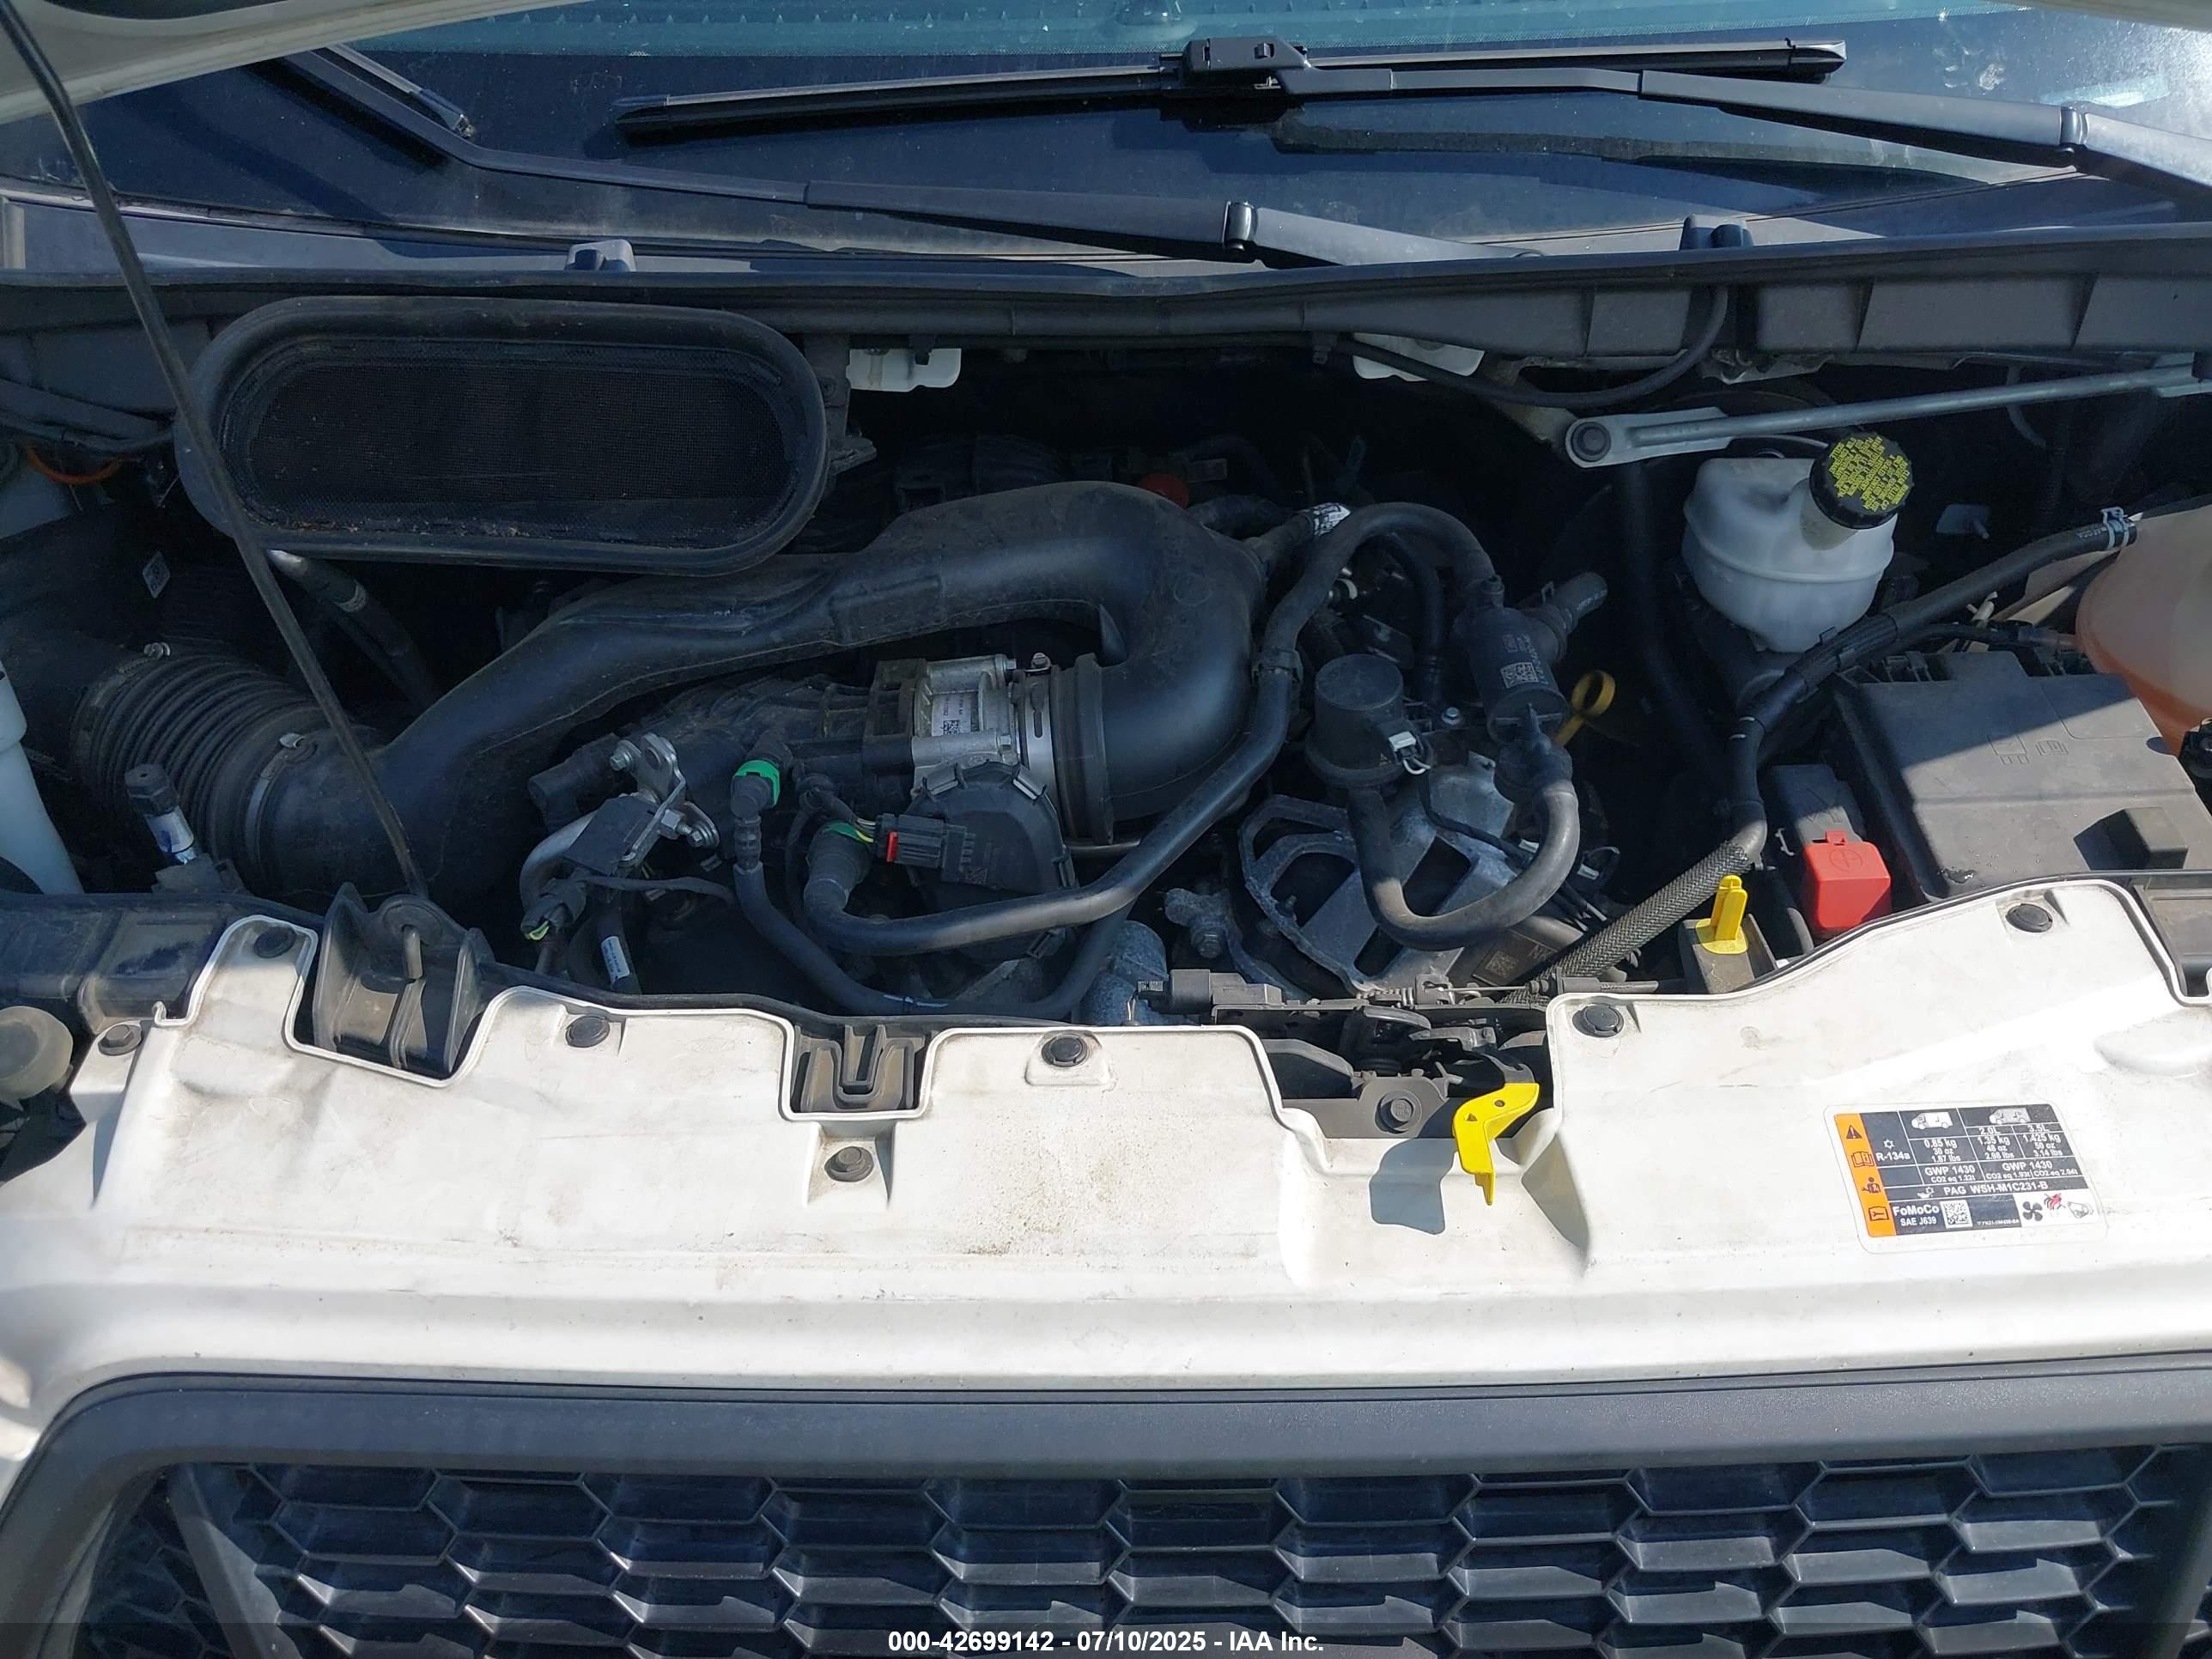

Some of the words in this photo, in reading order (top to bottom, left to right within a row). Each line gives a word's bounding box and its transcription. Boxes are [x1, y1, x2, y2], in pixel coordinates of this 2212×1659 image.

[1978, 1126, 2001, 1134] 2.0L
[2027, 1123, 2050, 1132] 3.5L
[1923, 1139, 1943, 1148] 0.85
[1944, 1138, 1958, 1148] kg
[1978, 1135, 1997, 1145] 1.35
[1996, 1135, 2011, 1146] kg
[2022, 1133, 2047, 1143] 1.425
[2048, 1133, 2061, 1143] kg
[1875, 1151, 1911, 1162] R-134a
[2002, 1162, 2027, 1170] GWP
[2029, 1160, 2053, 1170] 1430
[1924, 1167, 1948, 1176] GWP
[1952, 1165, 1975, 1175] 1430
[1943, 1186, 1966, 1195] PAG
[1970, 1181, 2048, 1194] WSH-M1C231-B
[1893, 1204, 1940, 1216] FoMoCo
[1899, 1218, 1917, 1227] SAE
